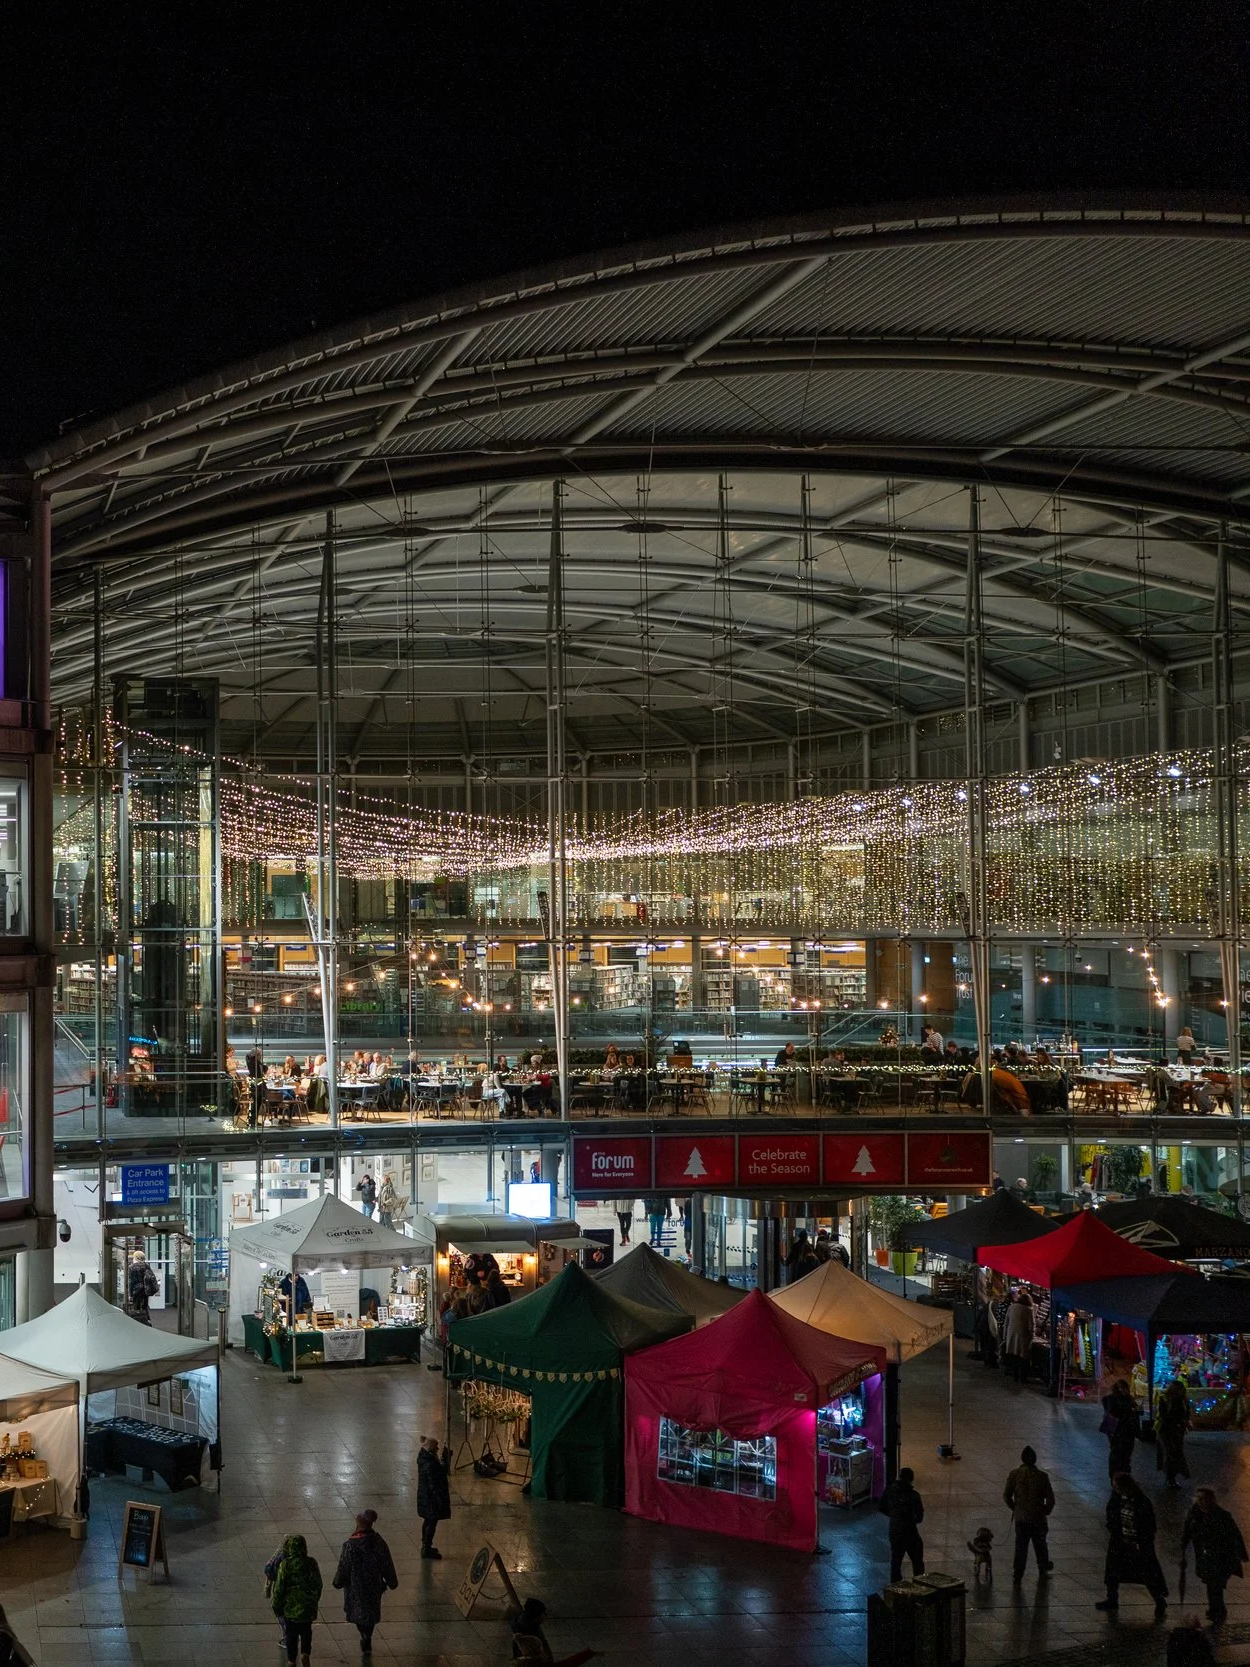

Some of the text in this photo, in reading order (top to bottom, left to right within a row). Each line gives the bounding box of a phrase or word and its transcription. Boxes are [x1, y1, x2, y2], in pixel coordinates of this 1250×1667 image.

[955, 969, 973, 983] Foru
[340, 1001, 380, 1010] Library
[752, 1149, 807, 1160] Celebrate
[591, 1152, 634, 1170] forum
[128, 1168, 164, 1178] Car Park
[748, 1163, 810, 1174] the Season
[127, 1179, 164, 1188] Entrance
[326, 1228, 360, 1238] Garden
